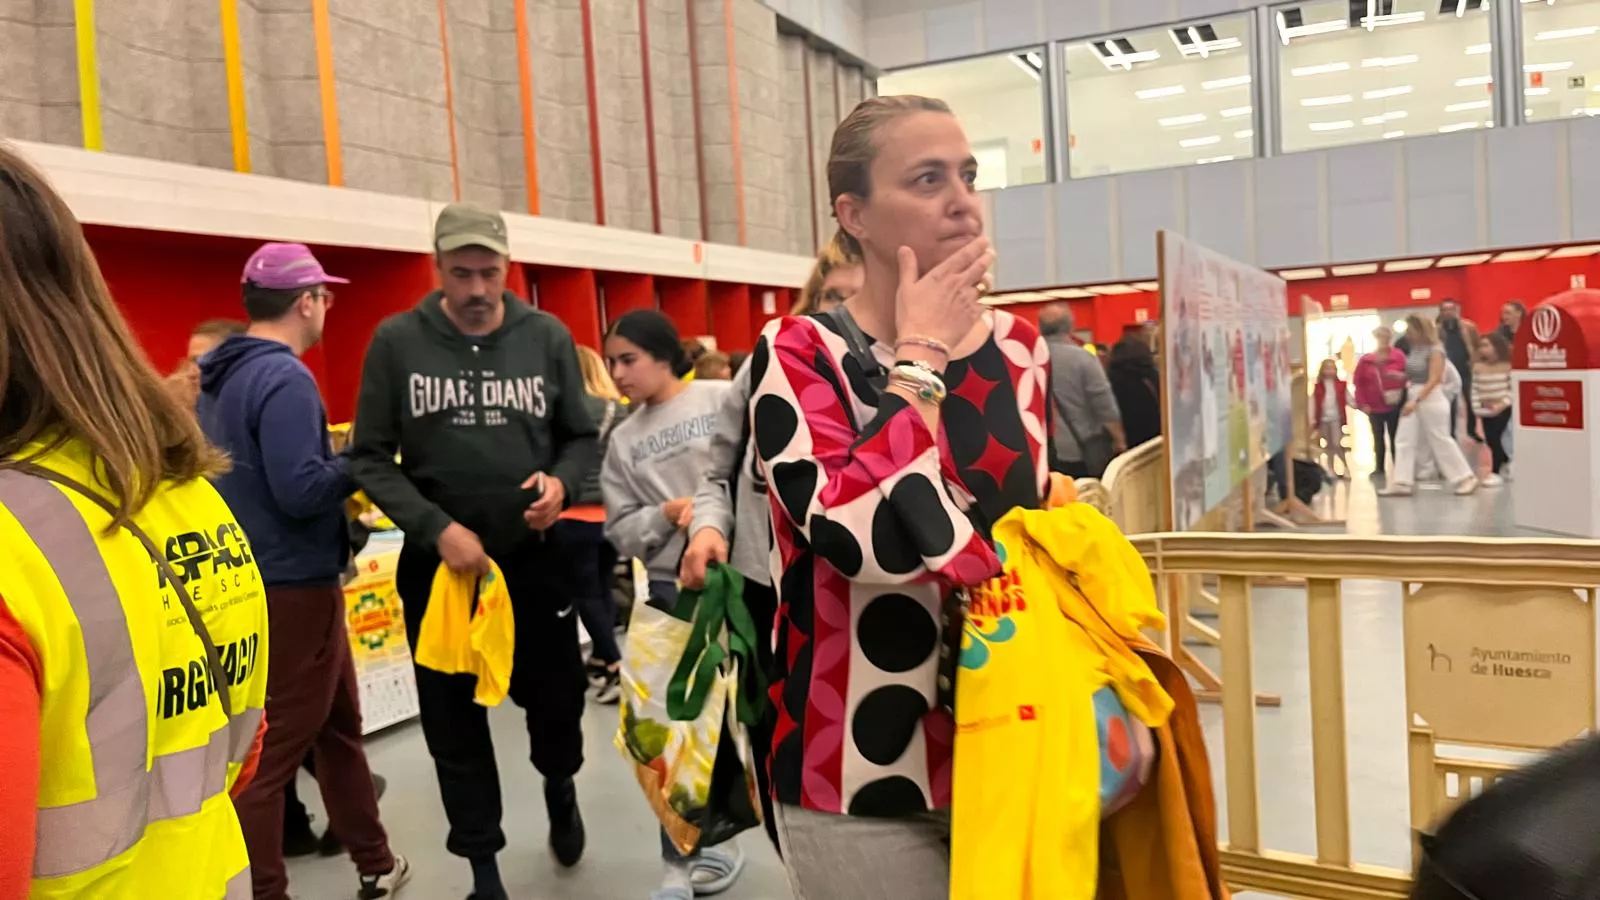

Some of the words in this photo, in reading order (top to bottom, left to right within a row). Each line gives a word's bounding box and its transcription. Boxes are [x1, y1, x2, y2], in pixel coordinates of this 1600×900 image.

[409, 372, 547, 418] GUARDIANS
[162, 569, 257, 612] HESCA
[1470, 647, 1571, 664] Ayuntamiento
[1470, 662, 1488, 675] de
[1493, 663, 1552, 679] Huesca
